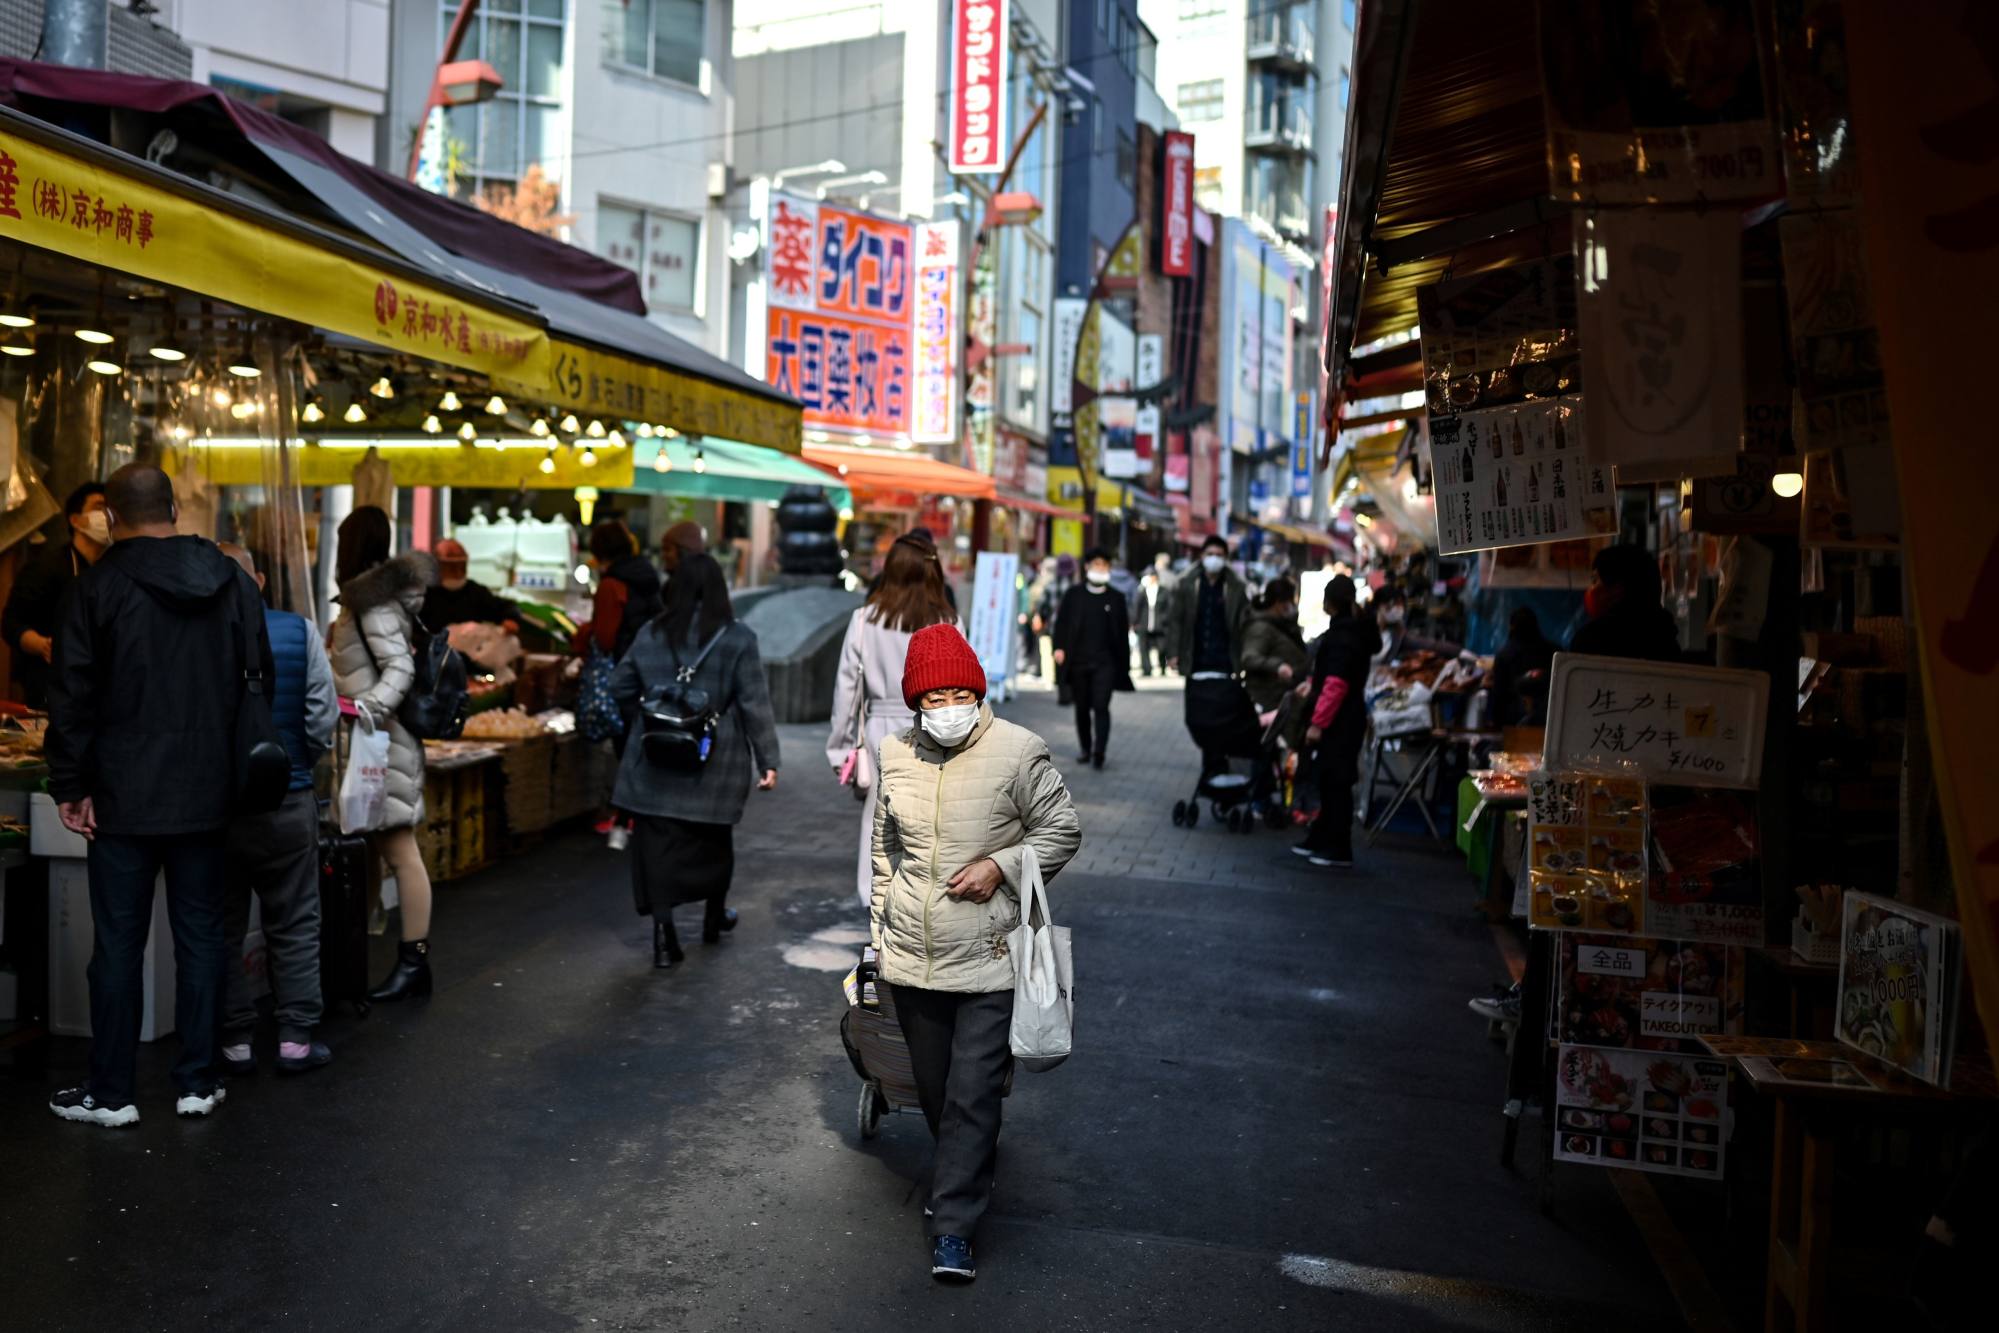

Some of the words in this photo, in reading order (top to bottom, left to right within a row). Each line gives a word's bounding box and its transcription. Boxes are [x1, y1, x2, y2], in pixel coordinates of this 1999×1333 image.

[962, 4, 996, 165] サンドラッグ
[32, 177, 155, 250] (株)京和商事
[772, 200, 812, 297] 薬
[821, 222, 908, 313] ダイコク
[402, 294, 473, 355] 京和水産
[550, 352, 583, 400] くら
[1592, 949, 1633, 971] 全品
[1643, 997, 1716, 1016] テイクアウト
[1871, 974, 1920, 1003] 1000円
[1642, 1019, 1697, 1034] TAKEOUT
